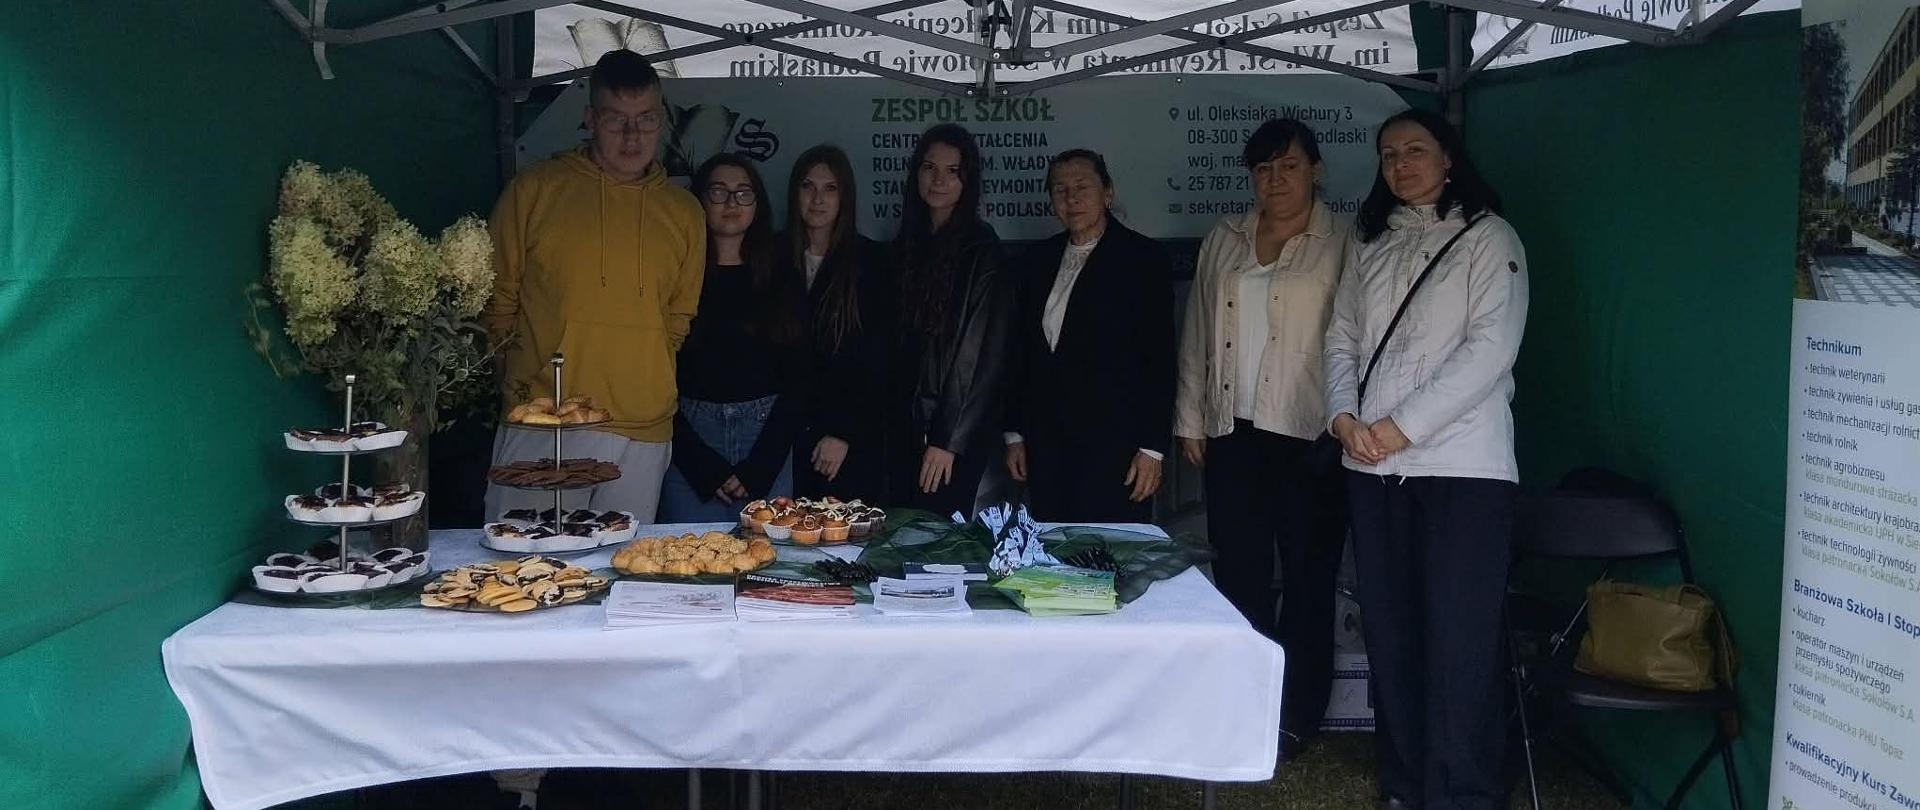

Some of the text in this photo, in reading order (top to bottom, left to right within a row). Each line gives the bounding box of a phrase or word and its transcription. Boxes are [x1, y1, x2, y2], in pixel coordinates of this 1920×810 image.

[975, 93, 1055, 122] SZKÓŁ
[1187, 105, 1353, 123] ul. Oleksiaka Wichury 3
[872, 133, 1048, 149] CENTR TAŁCENIA
[1188, 130, 1238, 144] 08-300
[1188, 154, 1217, 170] woj.
[982, 179, 1050, 194] EYMONTA
[1188, 176, 1207, 191] 25
[1209, 176, 1234, 191] 787
[873, 203, 888, 218] W
[986, 202, 1054, 217] PODLASK
[1805, 336, 1862, 356] Technikum
[1810, 362, 1886, 385] technik weterynarii
[1808, 385, 1836, 401] technik
[1880, 396, 1905, 415] usług
[1807, 407, 1835, 424] technik
[1836, 413, 1891, 437] mechanizacji
[1806, 430, 1858, 452] technik rolnik
[1805, 452, 1886, 482] technik agrobiznesu
[1803, 490, 1920, 533] technik architektury krajobra
[1801, 528, 1829, 547] technik
[1830, 537, 1876, 563] technologii
[1905, 534, 1920, 551] Sie
[1793, 578, 1844, 609] Branżowa
[1846, 598, 1884, 623] Szkoła
[1887, 612, 1891, 626] I
[1796, 604, 1826, 627] kucharz
[1795, 629, 1828, 651] operator
[1828, 642, 1860, 665] maszyn
[1795, 644, 1834, 670] przemysłu
[1792, 681, 1827, 707] cukiernik
[1785, 730, 1861, 784] Kwalifikacyjny
[1862, 770, 1888, 796] Kurs
[1788, 761, 1839, 796] prowadzenie
